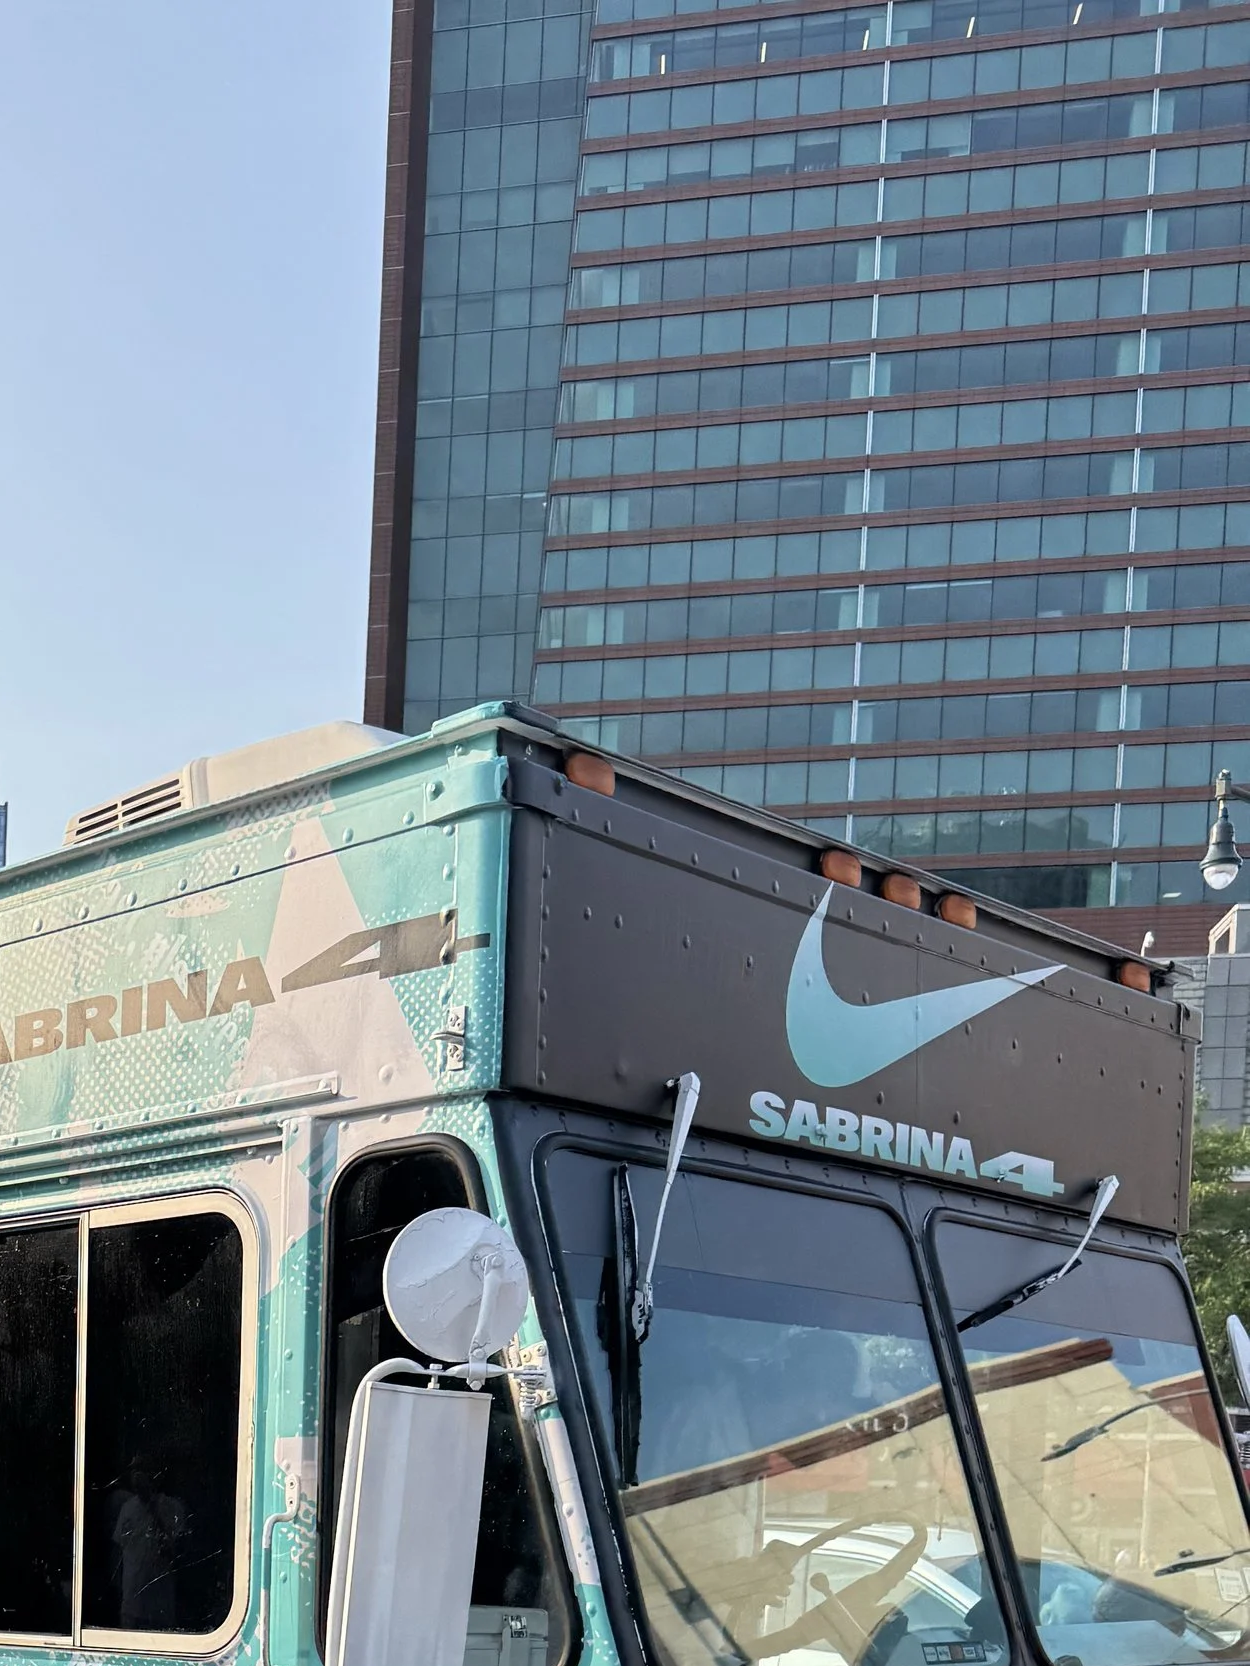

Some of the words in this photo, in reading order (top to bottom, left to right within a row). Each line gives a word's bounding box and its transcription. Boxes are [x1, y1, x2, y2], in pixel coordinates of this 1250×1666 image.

[281, 908, 490, 993] 4
[749, 1090, 979, 1180] SABRINA
[979, 1150, 1065, 1197] 4
